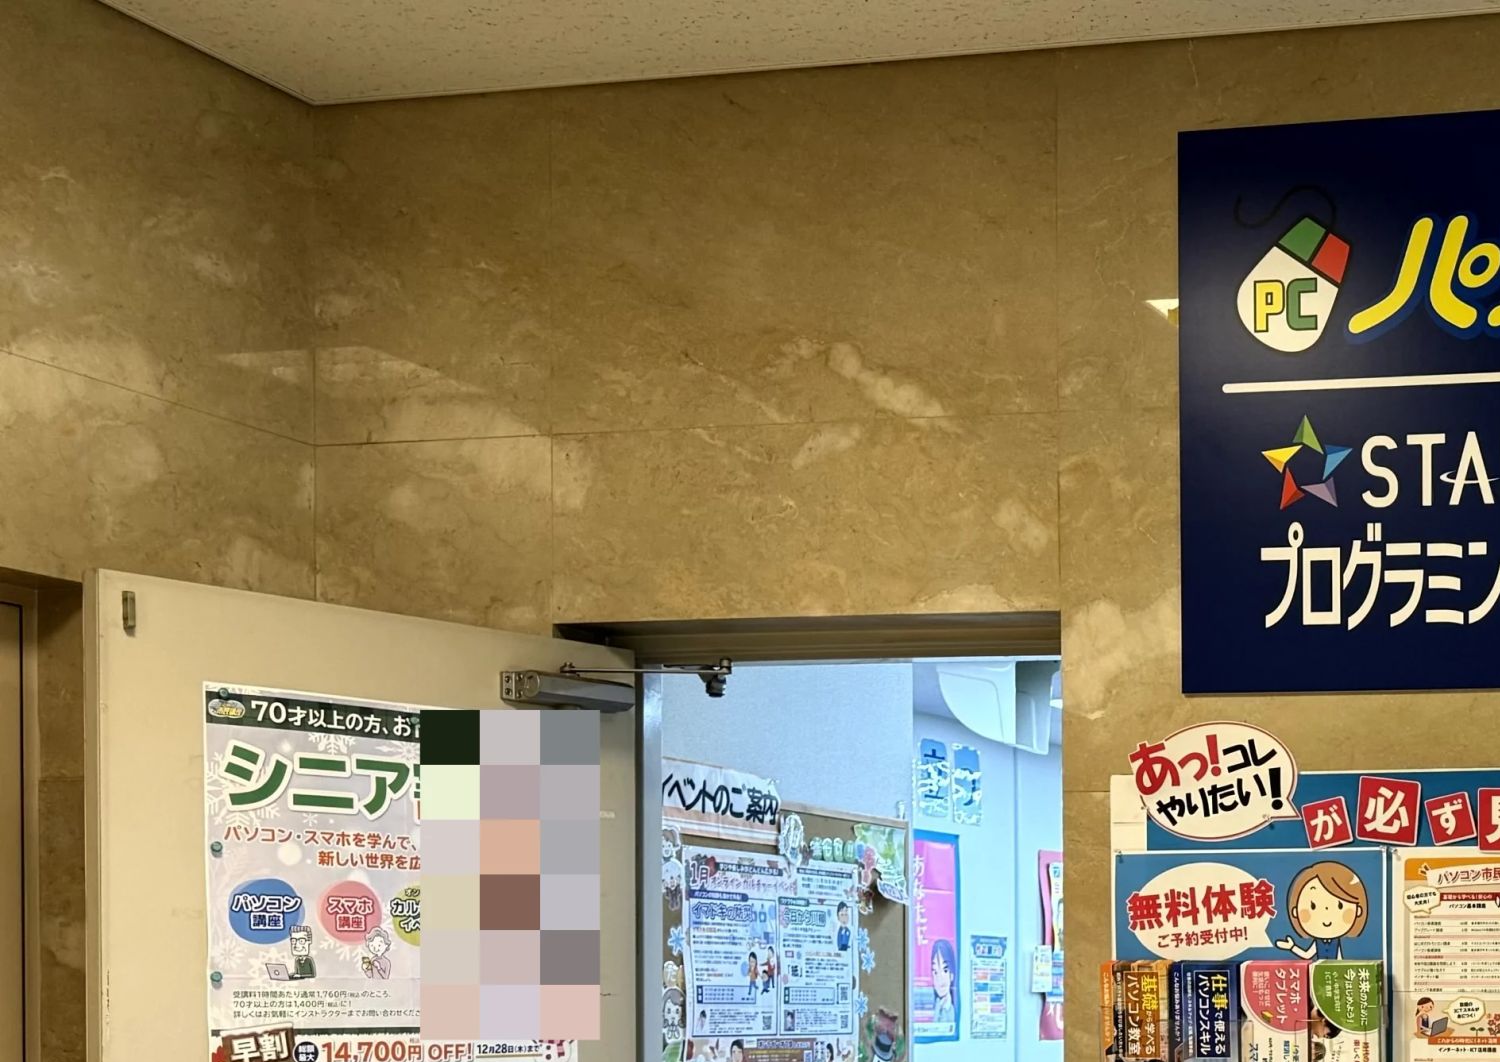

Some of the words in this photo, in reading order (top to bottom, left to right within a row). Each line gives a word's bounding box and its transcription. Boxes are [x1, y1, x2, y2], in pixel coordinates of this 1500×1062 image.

[1253, 276, 1320, 333] PC
[251, 700, 420, 739] 70才以上の方、お
[224, 745, 420, 815] シニア
[1157, 767, 1282, 826] やりたい!
[225, 826, 418, 851] パソコン・スマホを学んで、
[232, 895, 300, 913] パソコン
[328, 898, 373, 915] スマホ
[251, 914, 284, 930] 講座
[336, 916, 366, 931] 講座
[1127, 880, 1277, 930] 無料体験
[1158, 926, 1249, 948] ご予約受付中!
[1127, 974, 1141, 1055] パソコン教室
[1141, 975, 1158, 1054] 基礎から学べる
[1198, 974, 1211, 1055] パソコンスキル
[1211, 974, 1228, 1054] 仕事で使える
[1275, 968, 1288, 1024] タブレット
[1344, 968, 1355, 1023] 今はじめよう!
[1358, 968, 1370, 1026] 未来のために
[428, 1044, 472, 1061] OFF!
